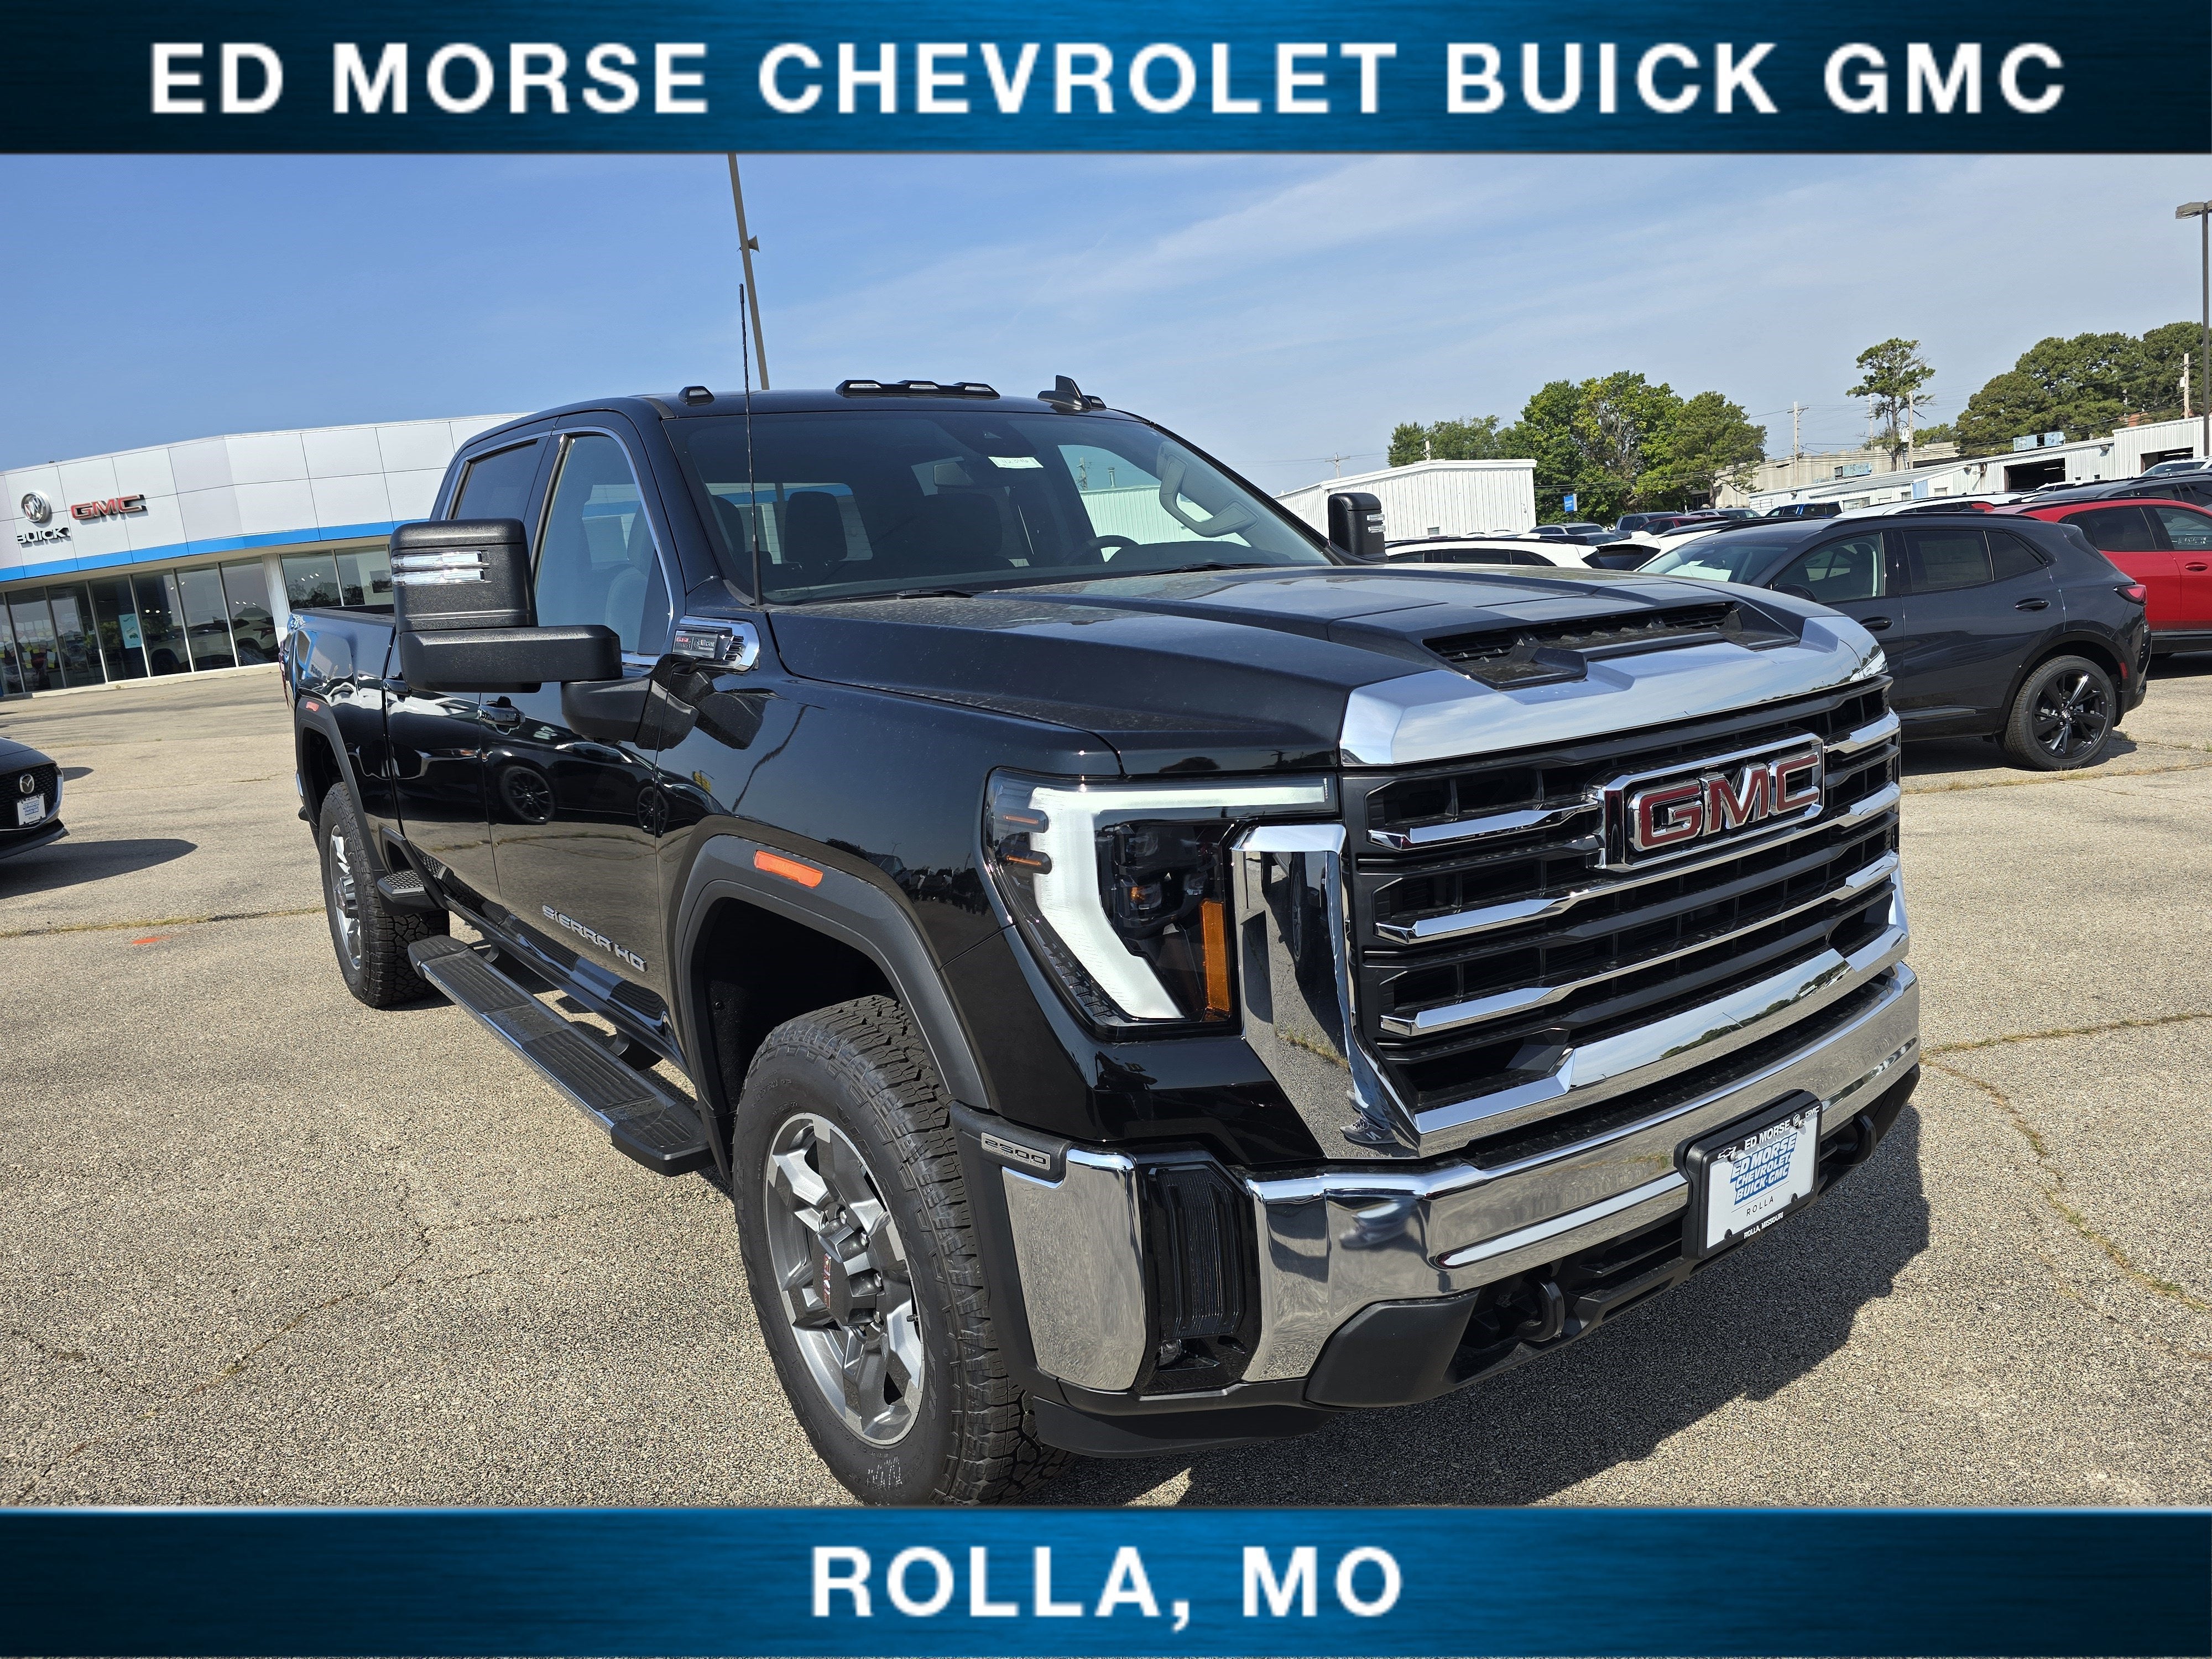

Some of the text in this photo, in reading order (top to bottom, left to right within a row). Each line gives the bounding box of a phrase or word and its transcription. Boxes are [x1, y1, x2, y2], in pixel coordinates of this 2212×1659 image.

[70, 494, 145, 520] GMC
[17, 528, 68, 544] BUICK
[1627, 749, 1820, 852] GMC
[542, 904, 647, 972] SIERRA HD
[1744, 1105, 1820, 1151] ED MORSE GMC
[985, 1138, 1046, 1165] 2500
[1731, 1134, 1797, 1180] ED MORSE
[1735, 1151, 1791, 1189] CHEVROLET
[1746, 1196, 1774, 1217] ROLLA
[1744, 1211, 1784, 1239] ROLLA, MISSOURI
